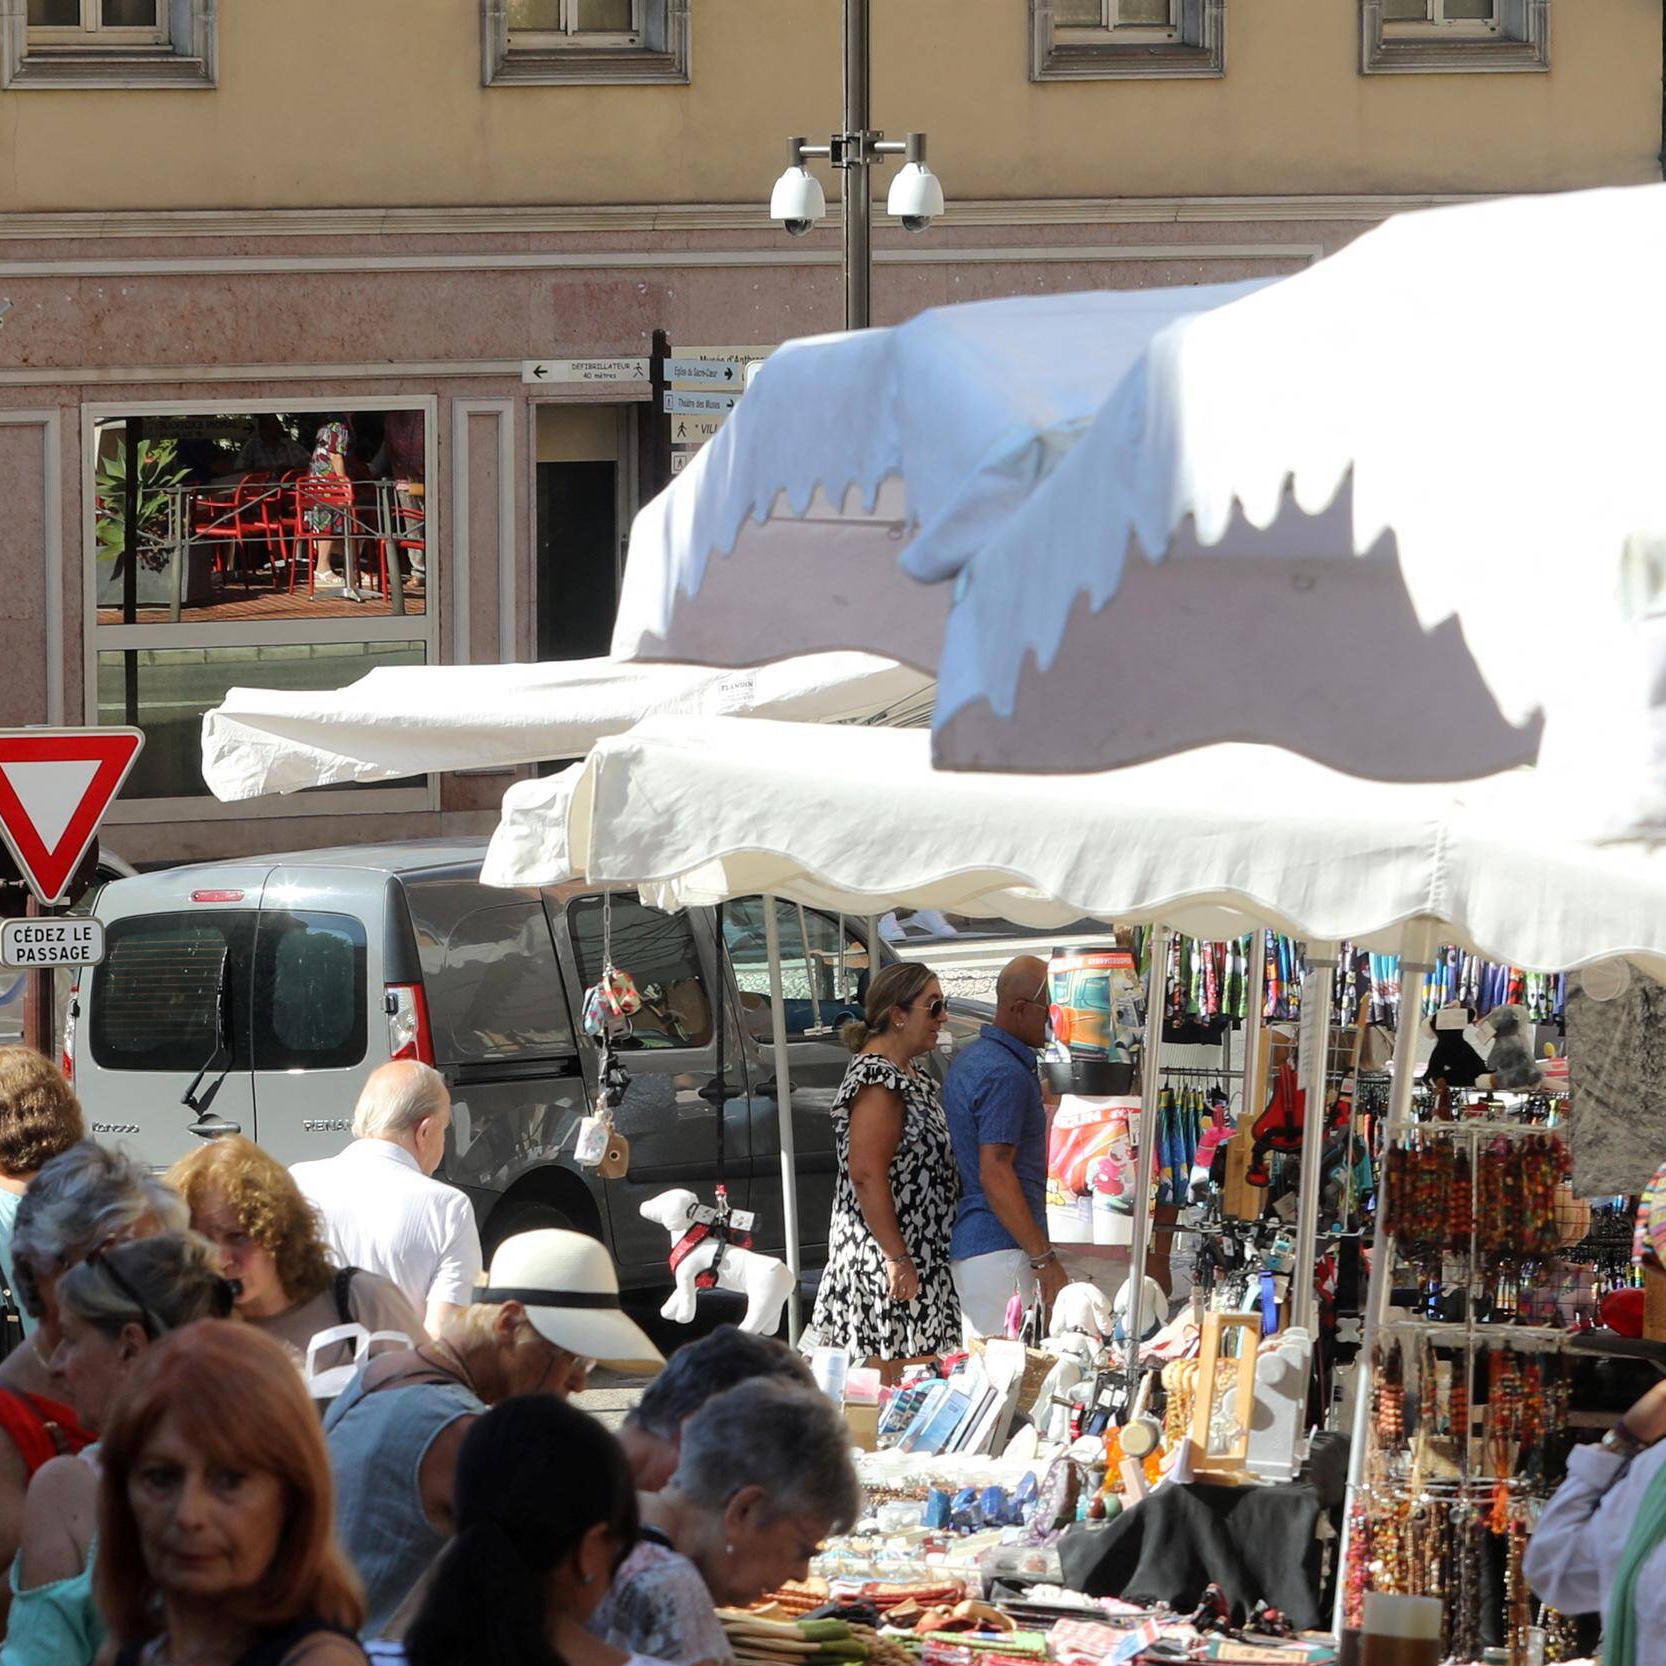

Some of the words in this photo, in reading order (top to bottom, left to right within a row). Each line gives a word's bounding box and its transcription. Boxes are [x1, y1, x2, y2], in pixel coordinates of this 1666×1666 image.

[13, 927, 65, 943] CÉDEZ
[73, 926, 93, 941] LE
[16, 945, 90, 963] PASSAGE
